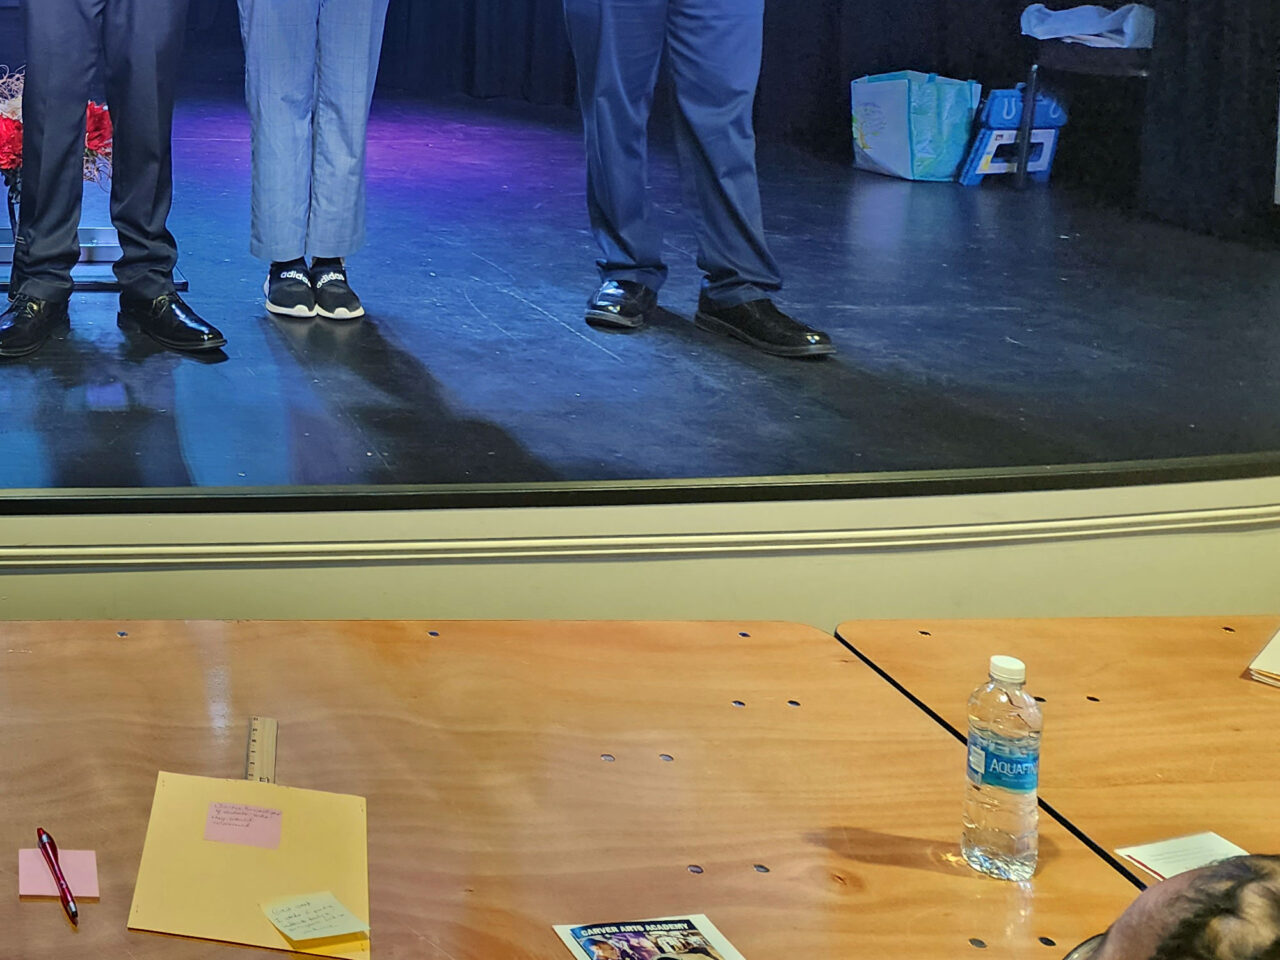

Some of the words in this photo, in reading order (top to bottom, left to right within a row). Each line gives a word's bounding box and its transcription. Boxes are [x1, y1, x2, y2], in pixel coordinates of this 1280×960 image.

[990, 758, 1038, 776] AQUAFIN
[580, 925, 620, 936] CARVER
[620, 924, 644, 934] ARTS
[646, 922, 689, 932] ACADEMY
